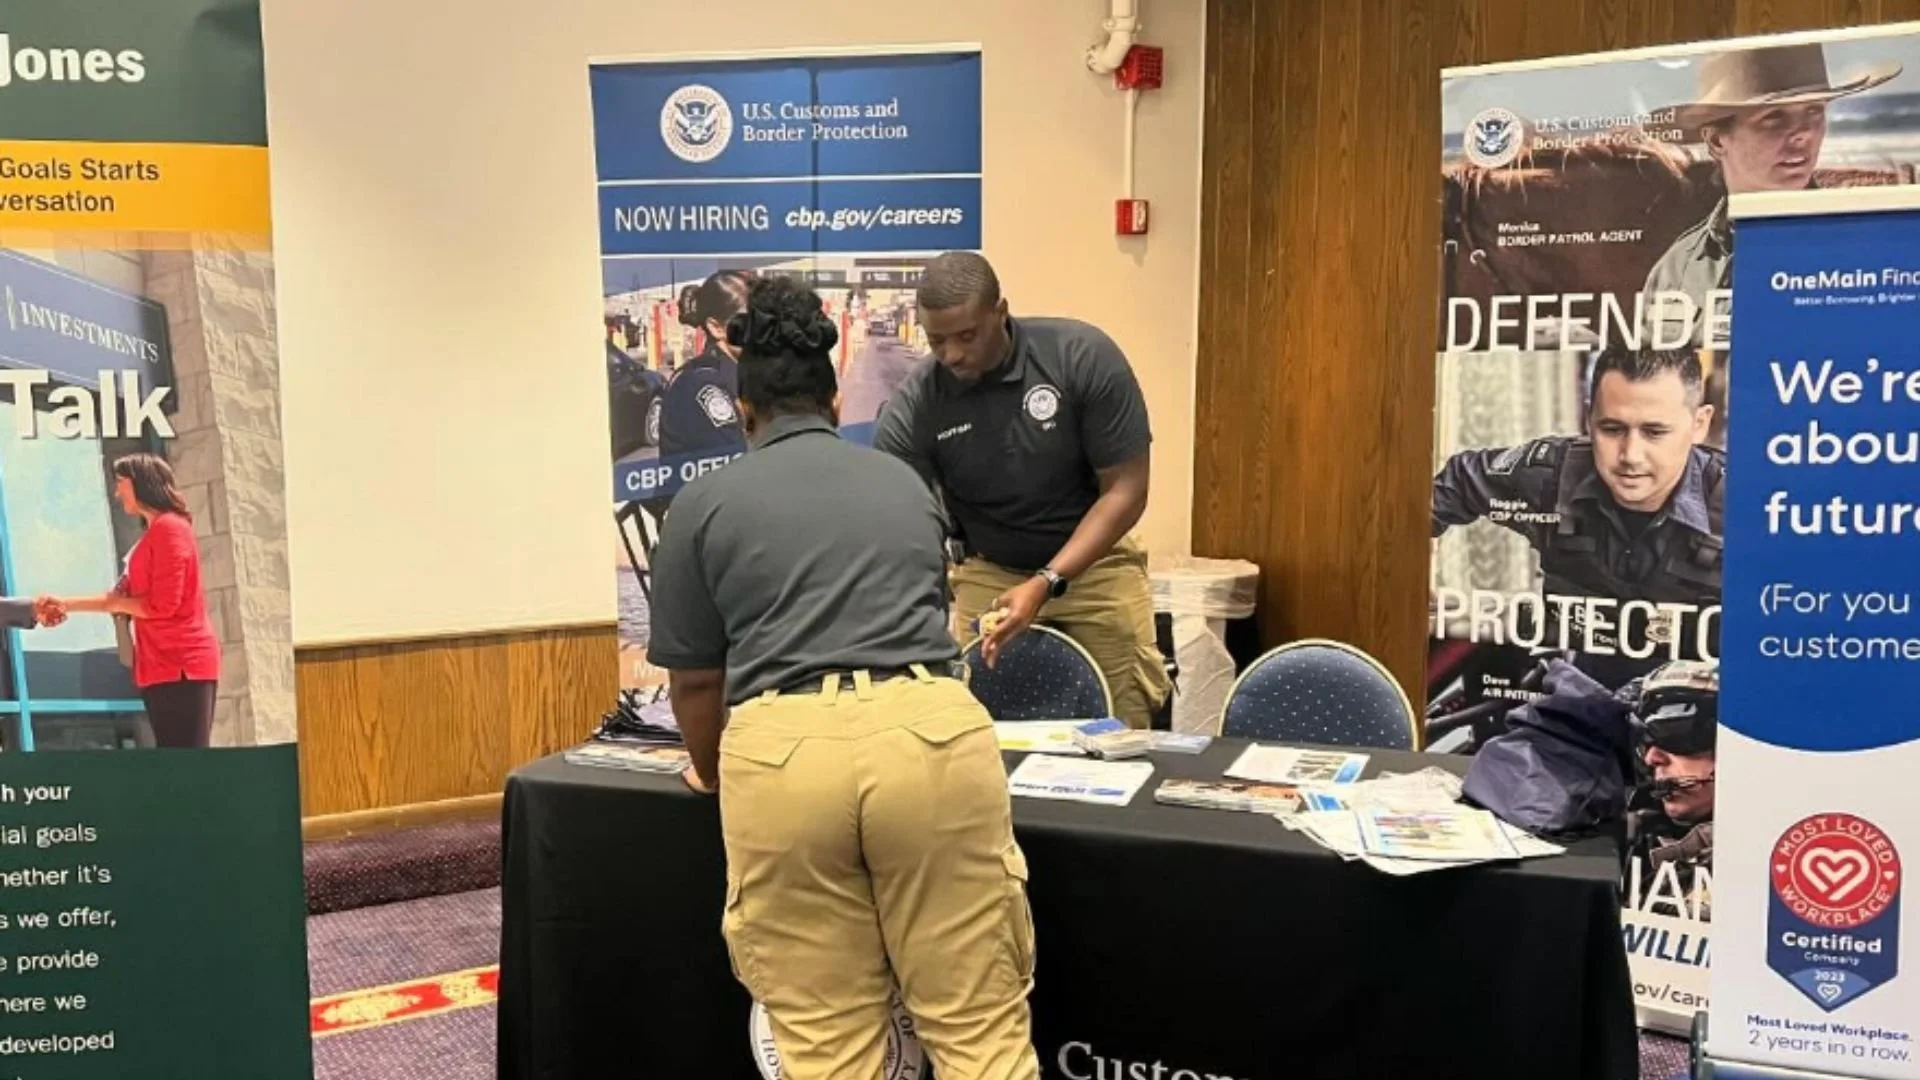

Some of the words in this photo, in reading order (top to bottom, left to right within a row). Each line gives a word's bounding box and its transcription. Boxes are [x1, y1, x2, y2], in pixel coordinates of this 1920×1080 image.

[742, 102, 776, 121] U.S.
[780, 100, 861, 120] Customs
[864, 98, 899, 118] and
[742, 123, 805, 142] Border
[811, 121, 908, 141] Protection
[0, 157, 72, 180] Goals
[80, 158, 160, 181] Starts
[615, 207, 674, 231] NOW
[679, 205, 769, 231] HIRING
[785, 203, 963, 231] cbp.gov/careers
[1549, 232, 1597, 245] PATROL
[1599, 229, 1643, 243] AGENT
[1770, 268, 1877, 291] OneMain
[1447, 288, 1733, 352] DEFENDE
[20, 301, 161, 364] INVESTMENTS
[0, 369, 177, 438] Talk
[626, 465, 673, 491] CBP
[1764, 491, 1920, 535] futur
[1760, 583, 1831, 616] (For
[1843, 592, 1910, 621] you
[1760, 633, 1920, 659] custome
[23, 784, 72, 805] your
[36, 822, 97, 848] goals
[1779, 818, 1828, 857] MOST
[1836, 817, 1894, 864] LOVED
[77, 864, 113, 884] it's
[17, 911, 49, 929] we
[58, 906, 117, 928] offer,
[1782, 931, 1882, 954] Certified
[17, 949, 100, 975] provide
[1804, 951, 1860, 967] Company
[1814, 970, 1845, 983] 2023
[54, 994, 87, 1011] we
[1747, 1015, 1781, 1029] Most
[1785, 1018, 1827, 1033] Loved
[0, 1030, 115, 1055] developed
[1748, 1029, 1761, 1046] 2
[1767, 1034, 1823, 1053] years
[1827, 1040, 1847, 1056] in
[1851, 1045, 1865, 1058] a
